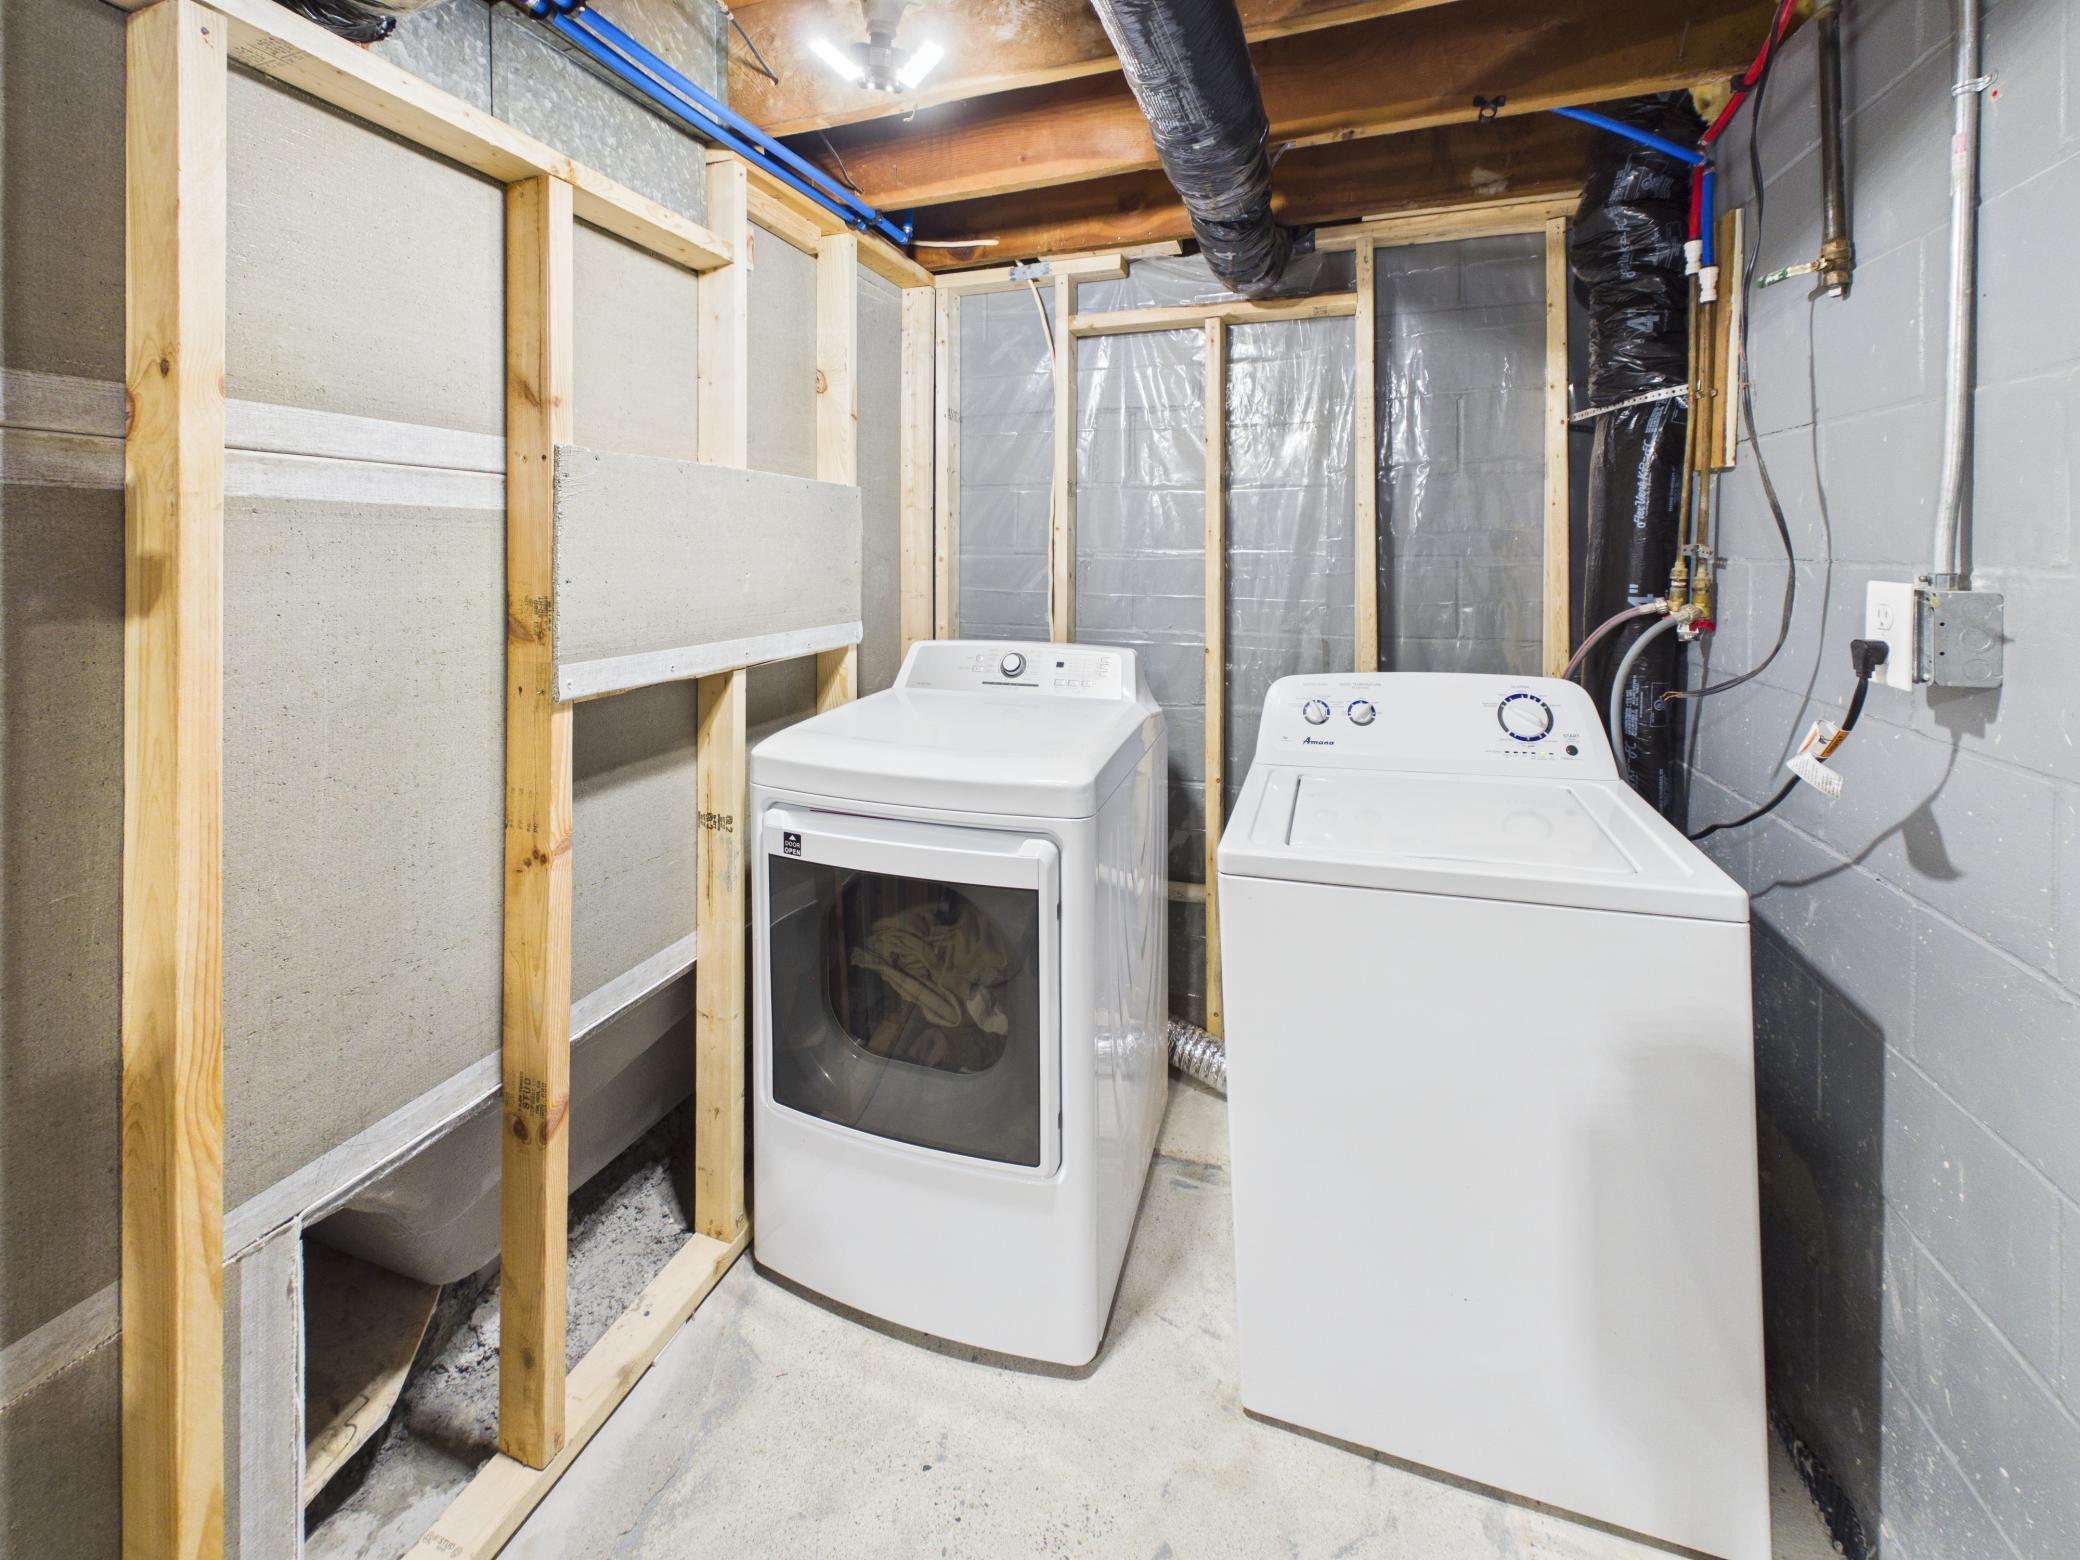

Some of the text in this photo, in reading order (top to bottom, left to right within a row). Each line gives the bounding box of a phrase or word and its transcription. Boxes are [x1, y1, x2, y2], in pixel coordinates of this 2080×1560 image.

[1302, 736, 1335, 746] Amana
[784, 840, 801, 849] DOOR
[784, 847, 801, 856] OPEN
